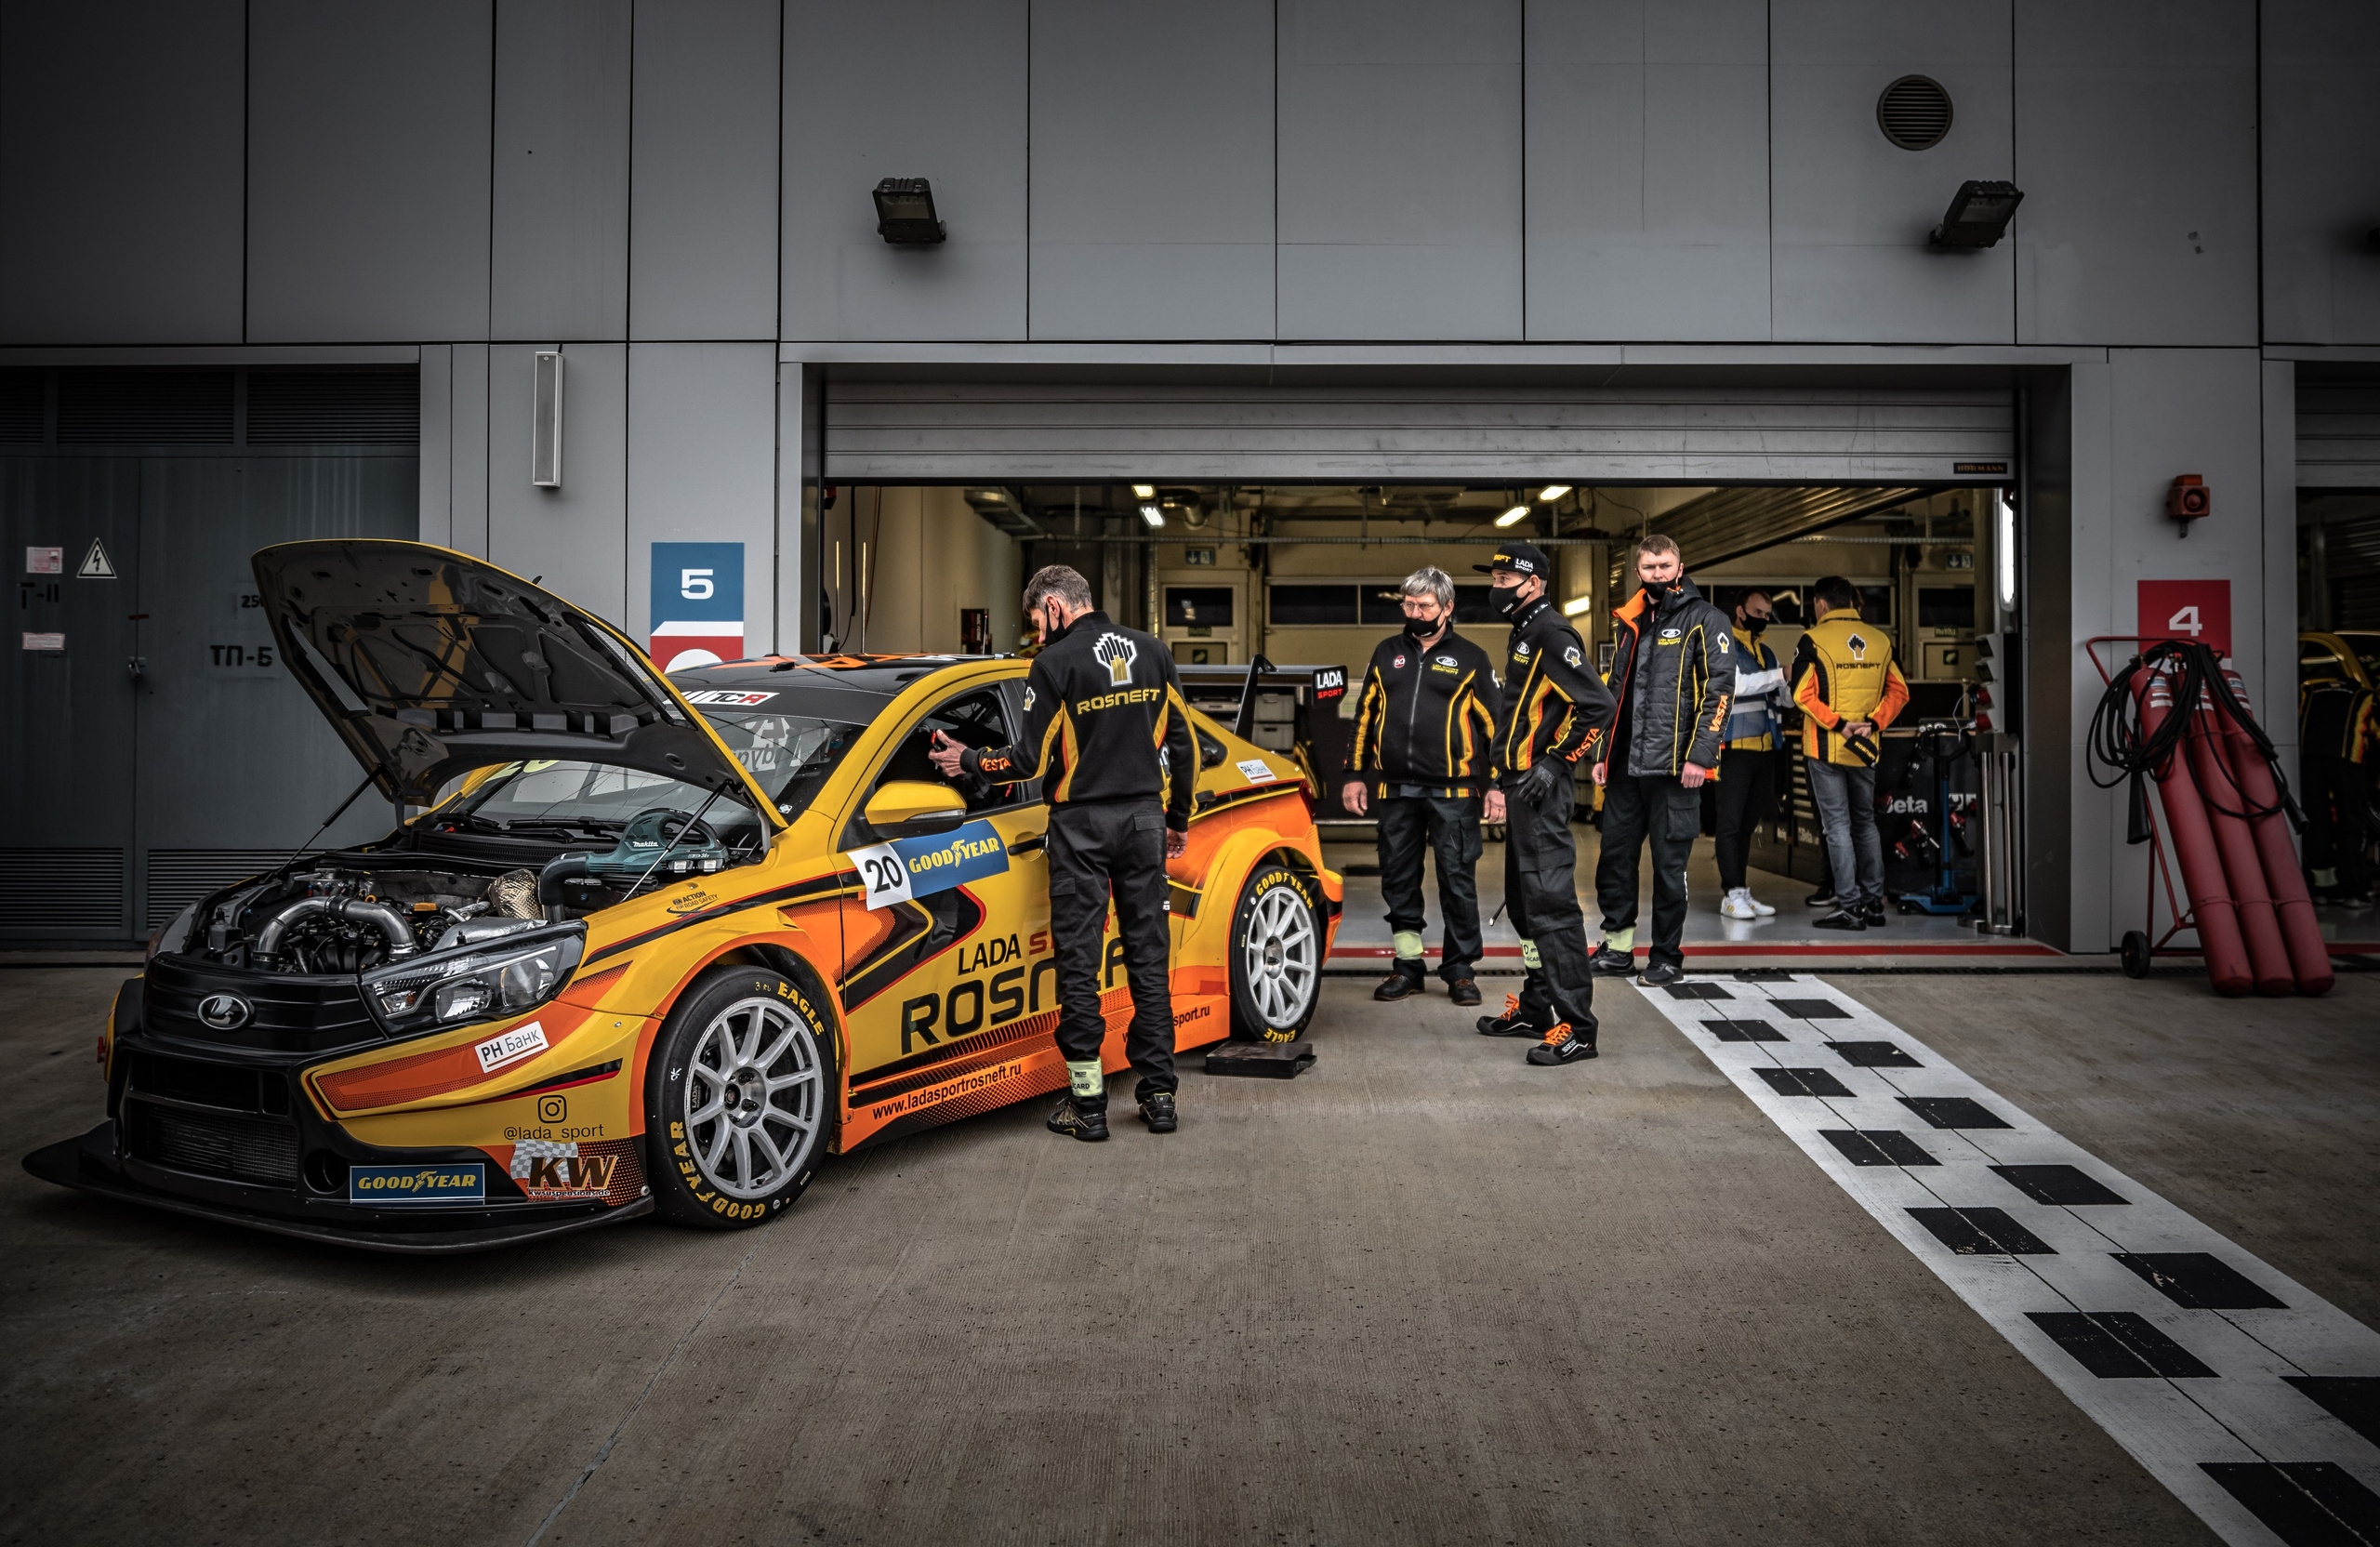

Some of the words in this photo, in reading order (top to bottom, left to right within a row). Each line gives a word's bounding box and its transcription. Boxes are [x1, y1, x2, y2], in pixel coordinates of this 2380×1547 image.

[1514, 564, 1533, 573] SPORT
[1515, 558, 1534, 569] LADA
[681, 568, 714, 600] 5
[2168, 605, 2203, 637] 4
[1836, 662, 1882, 670] ROSNEFT
[1316, 670, 1343, 689] LADA
[709, 692, 769, 704] TCR
[1077, 688, 1160, 715] ROSNEFT
[1317, 688, 1343, 699] SPORT
[1709, 694, 1728, 732] VESTA
[1565, 728, 1600, 762] VESTA
[864, 854, 904, 894] 20
[682, 891, 707, 903] ACTION
[699, 893, 719, 905] SAFETY
[958, 933, 1022, 976] LADA
[777, 981, 825, 1036] EAGLE
[481, 1041, 504, 1062] РН
[504, 1029, 541, 1052] Банк
[1263, 1027, 1296, 1043] EAGLE
[872, 1064, 1022, 1120] www.ladasportrosneft.ru
[503, 1124, 604, 1143] @lada_sport
[527, 1156, 620, 1191] KW
[528, 1189, 611, 1197] kwsuspensions.de
